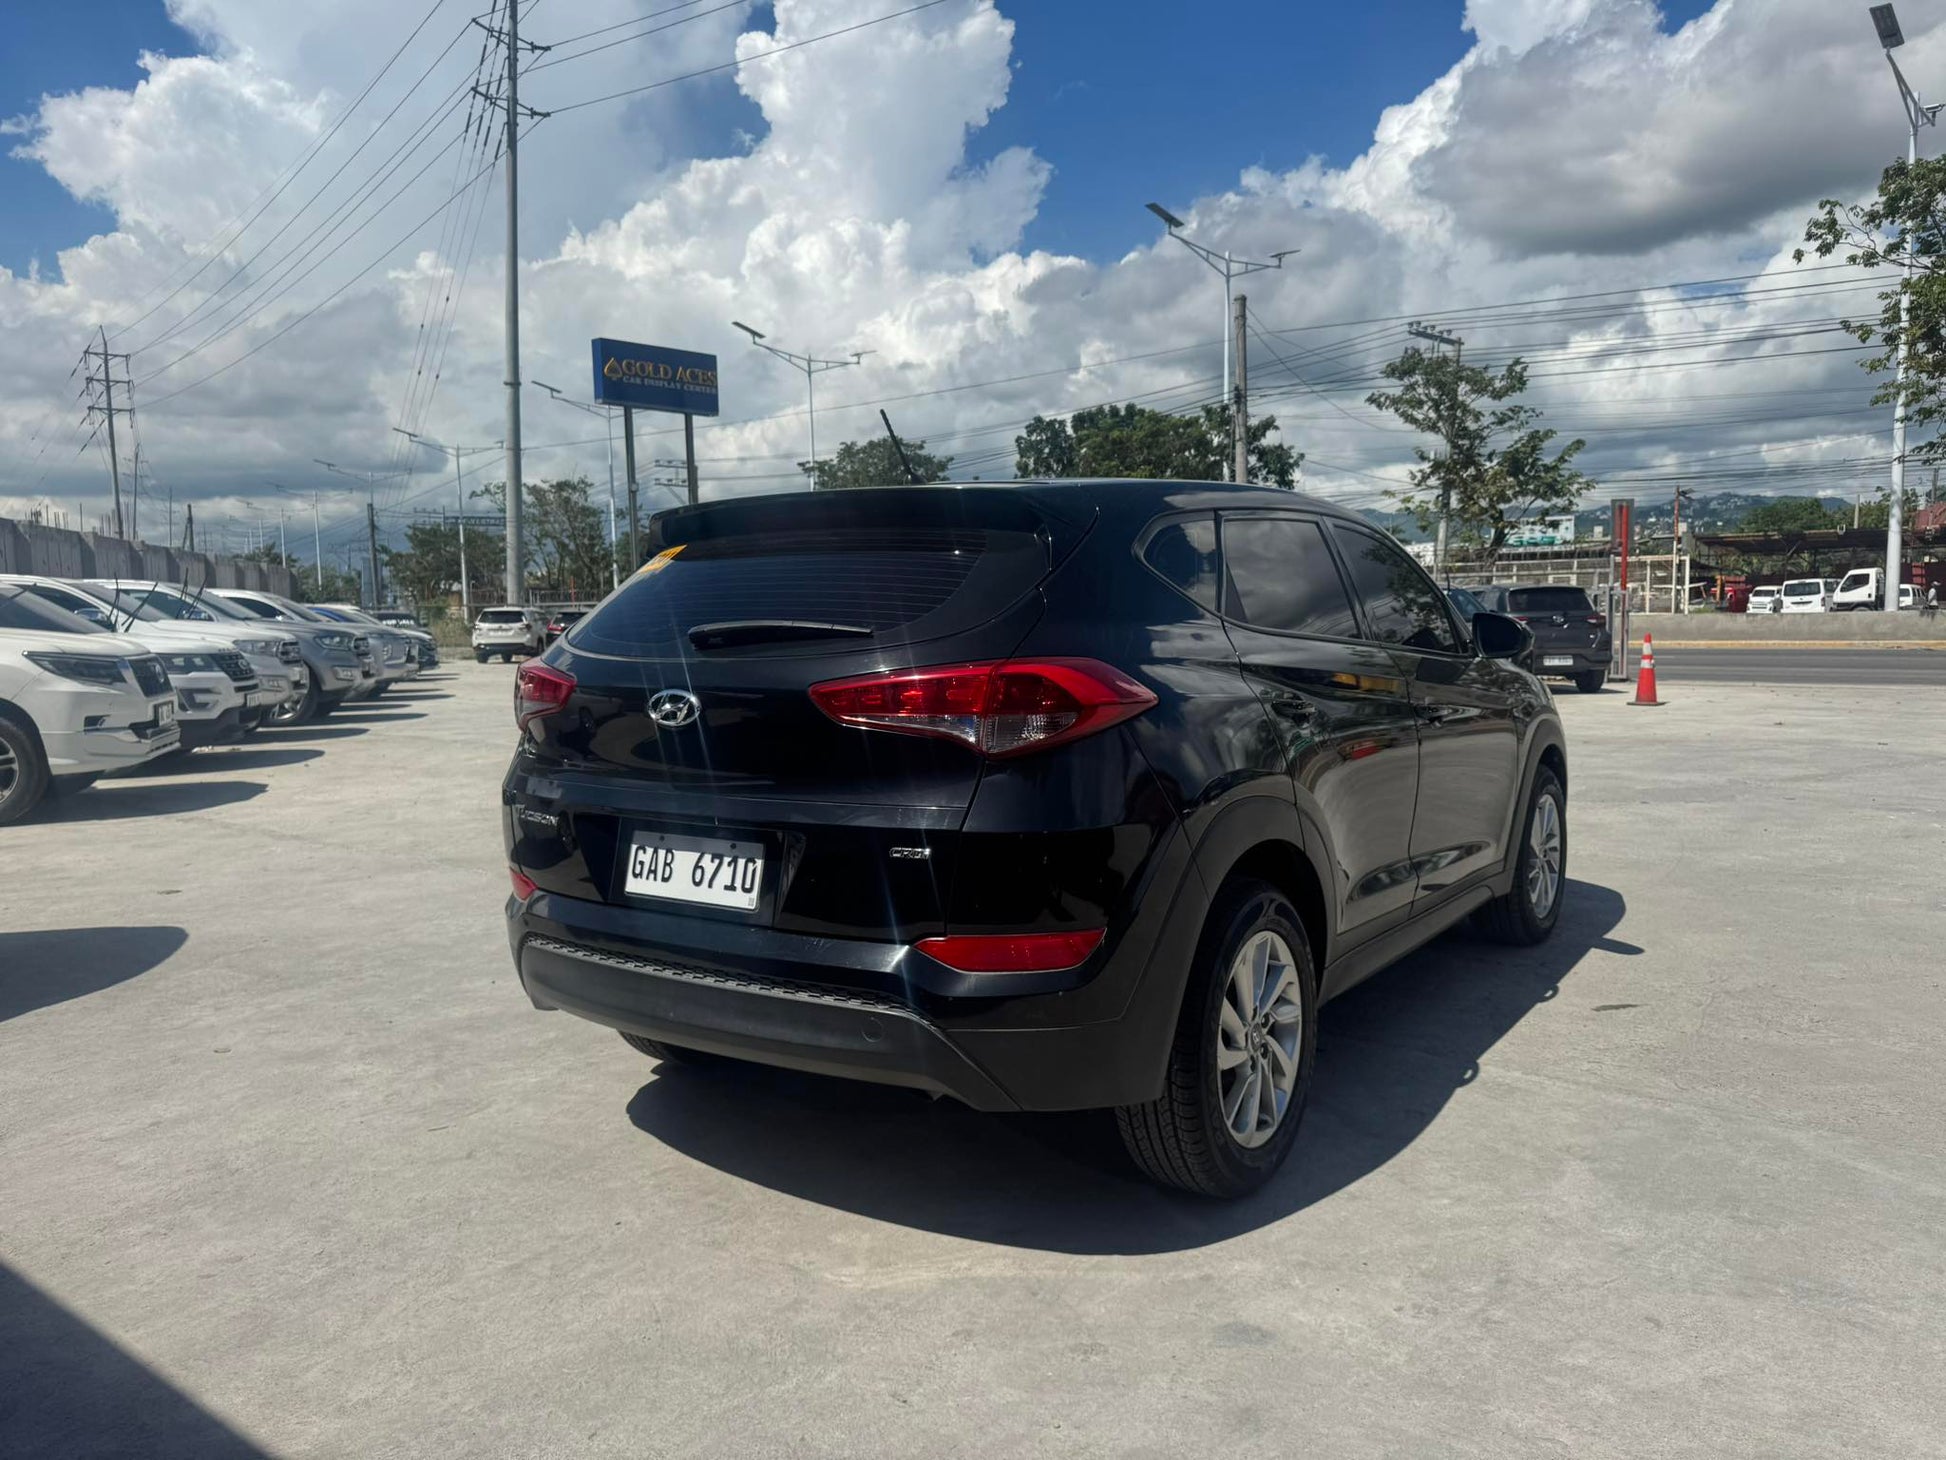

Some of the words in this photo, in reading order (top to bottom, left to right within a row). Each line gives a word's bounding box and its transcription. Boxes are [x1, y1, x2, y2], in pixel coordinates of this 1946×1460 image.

[622, 359, 672, 380] GOLD
[676, 366, 717, 386] ACES
[631, 845, 675, 883] GAB
[691, 852, 758, 894] 6710
